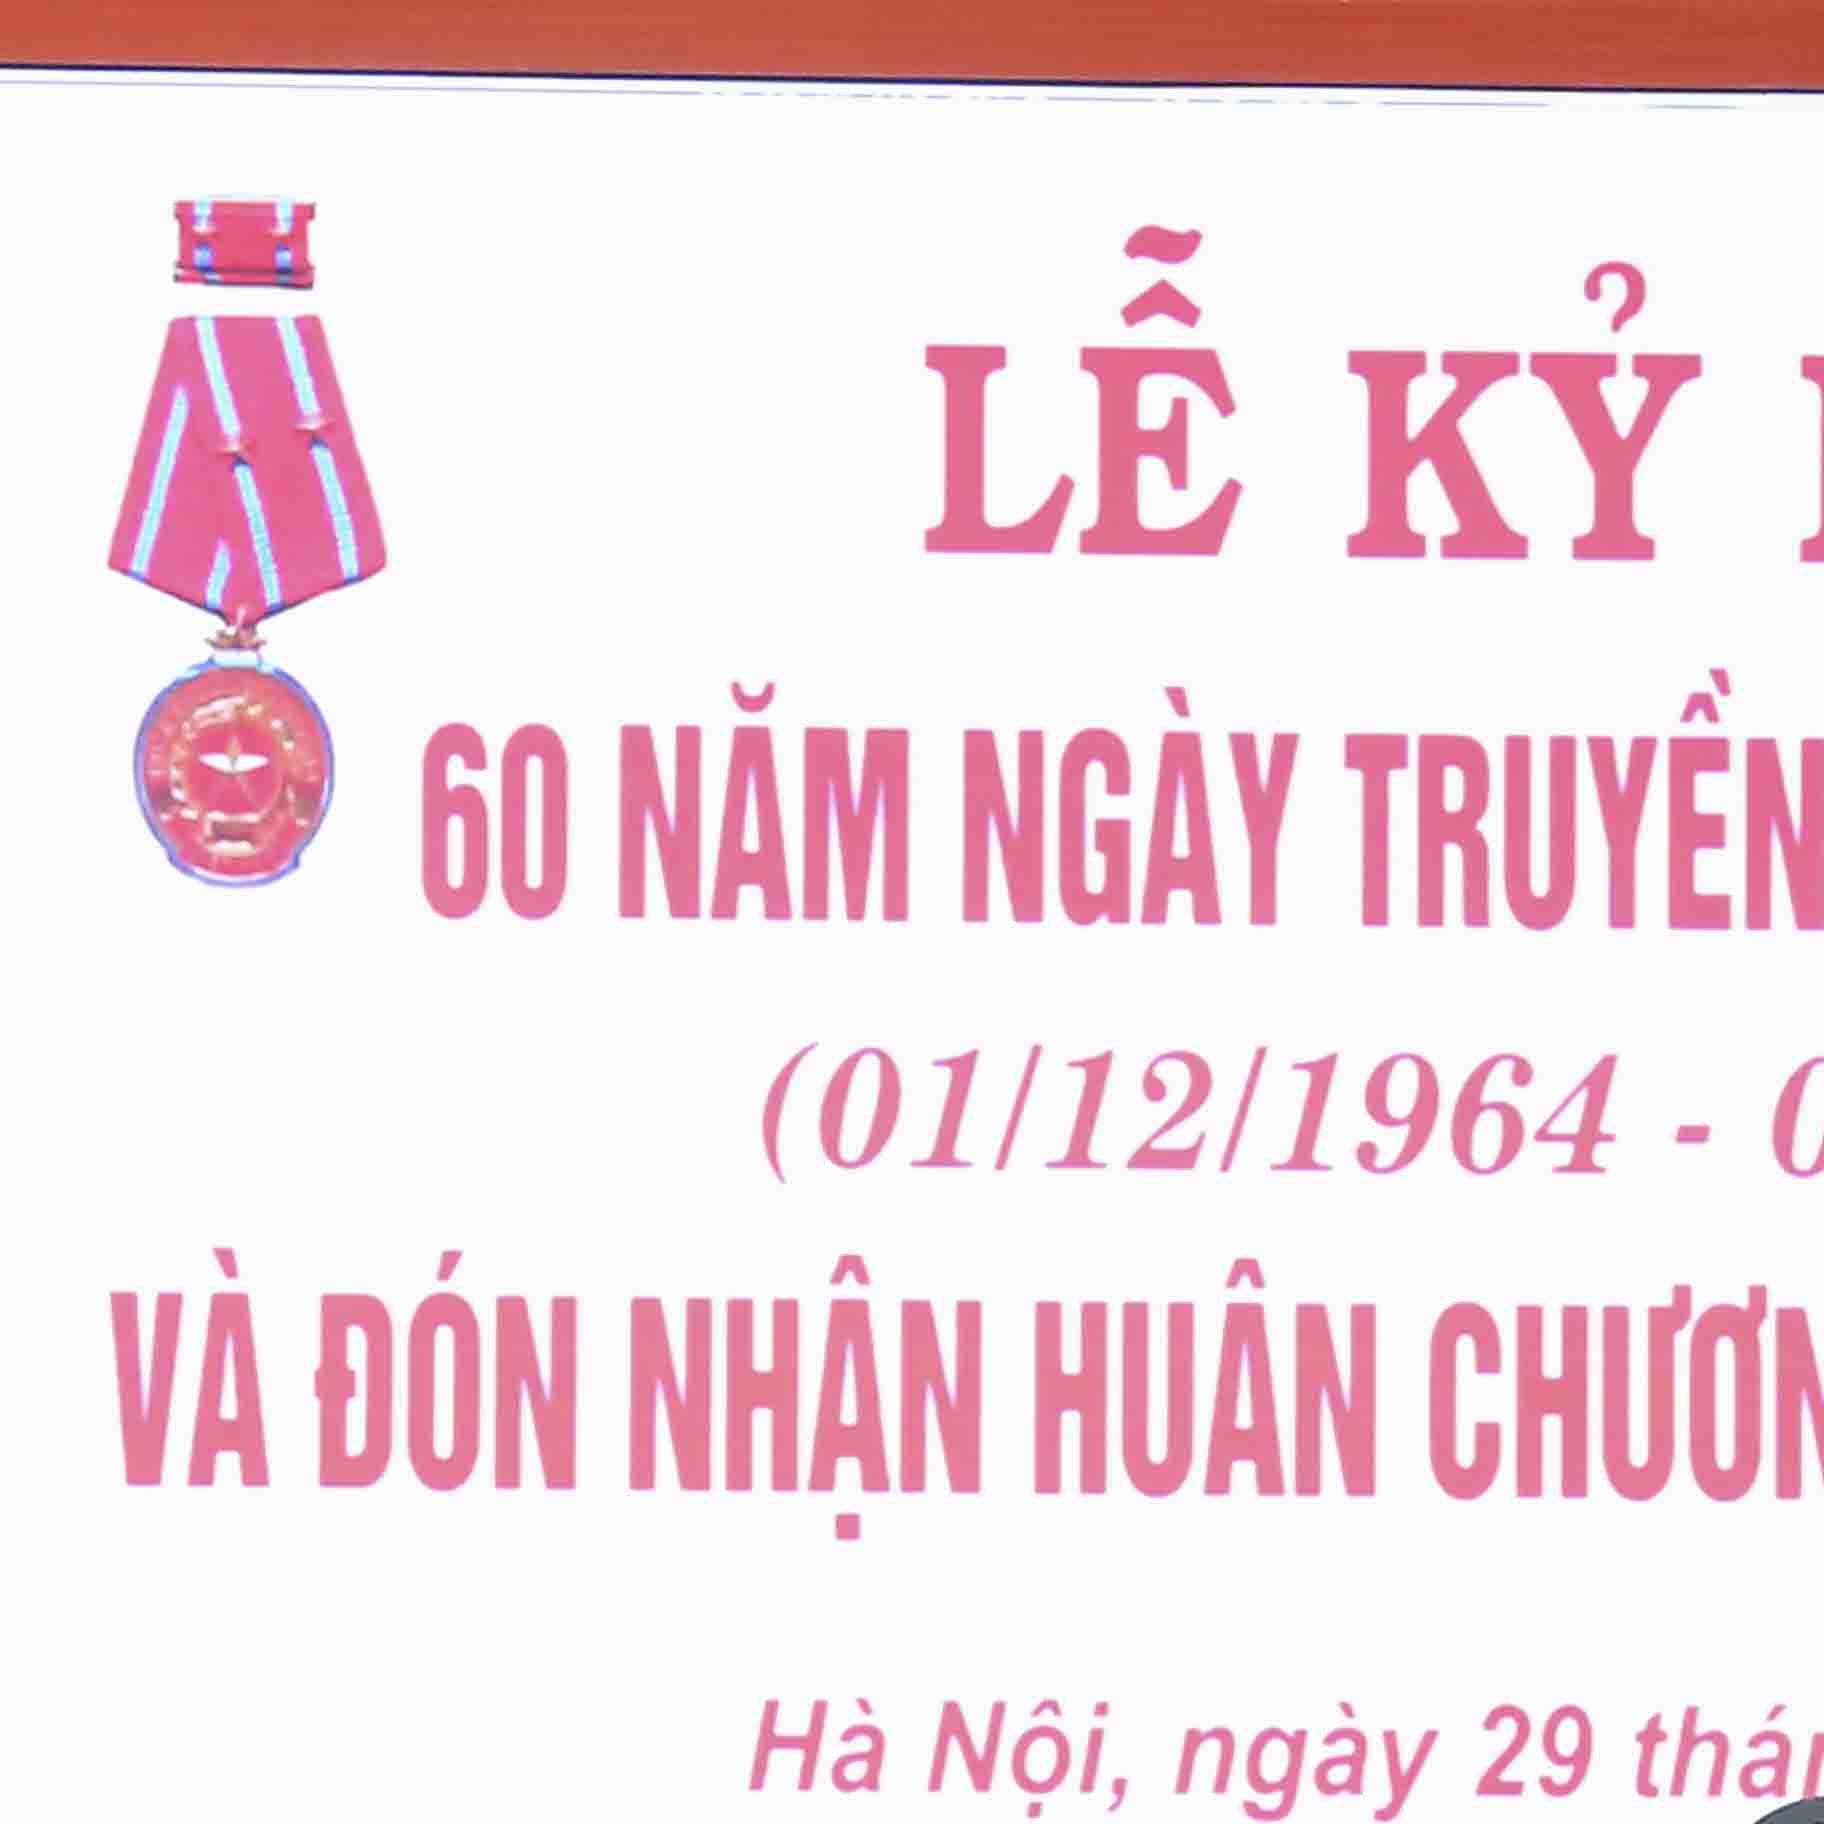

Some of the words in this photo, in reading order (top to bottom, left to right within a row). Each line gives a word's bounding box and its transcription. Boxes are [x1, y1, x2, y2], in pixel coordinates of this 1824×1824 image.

[924, 224, 1243, 556] LỄ
[1346, 261, 1702, 560] KỶ
[421, 722, 569, 920] 60
[619, 681, 911, 922] NĂM
[963, 687, 1297, 927] NGÀY
[763, 1044, 1616, 1180] (01/12/1964
[1675, 1124, 1710, 1144] -
[112, 1248, 270, 1488] VÀ
[314, 1250, 577, 1492] ĐÓN
[629, 1254, 982, 1541] NHẬN
[1035, 1258, 1376, 1497] HUÂN
[751, 1698, 886, 1794] Hà
[929, 1699, 1125, 1819] Nội,
[1176, 1703, 1439, 1822] ngày
[1476, 1704, 1593, 1800] 29
